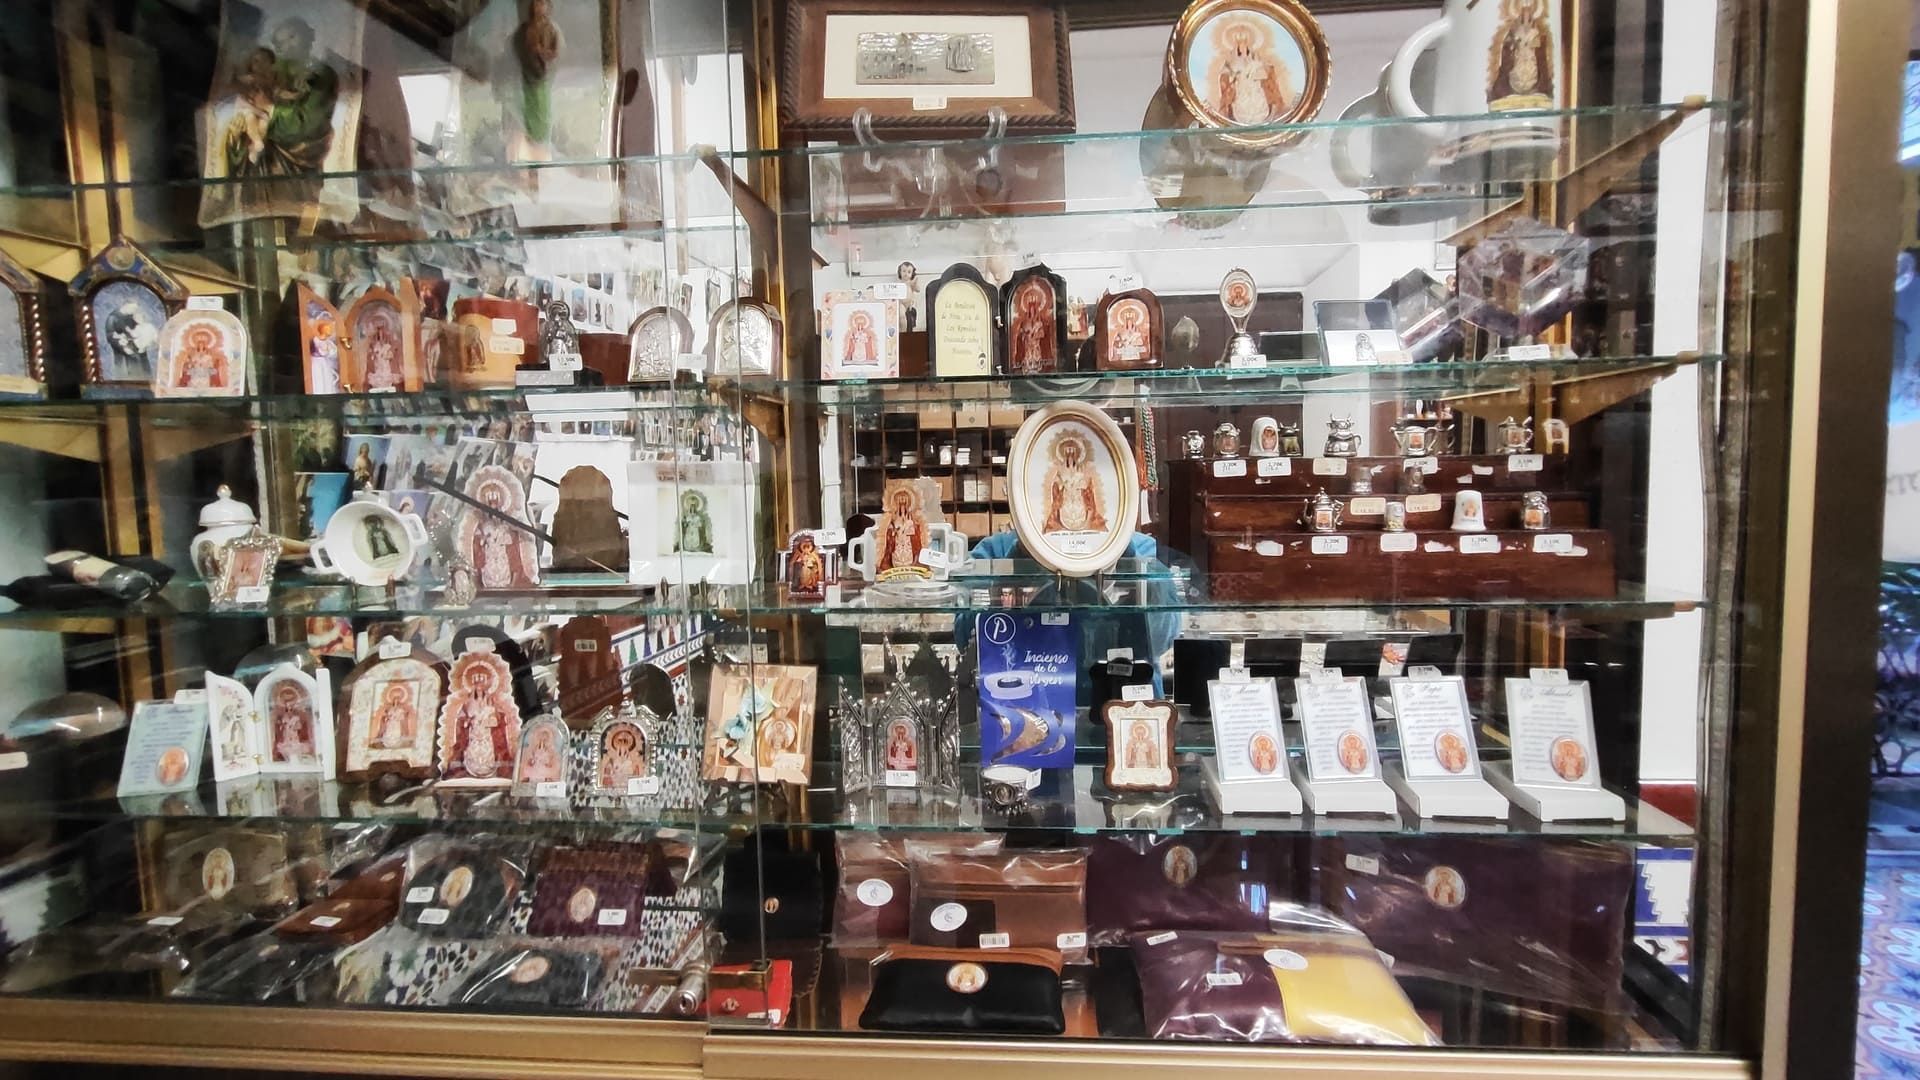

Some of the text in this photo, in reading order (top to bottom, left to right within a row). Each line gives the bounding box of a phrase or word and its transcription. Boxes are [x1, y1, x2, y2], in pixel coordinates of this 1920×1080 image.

[1024, 650, 1069, 664] Incienso
[1034, 663, 1058, 673] de la
[1030, 673, 1064, 687] Virgen
